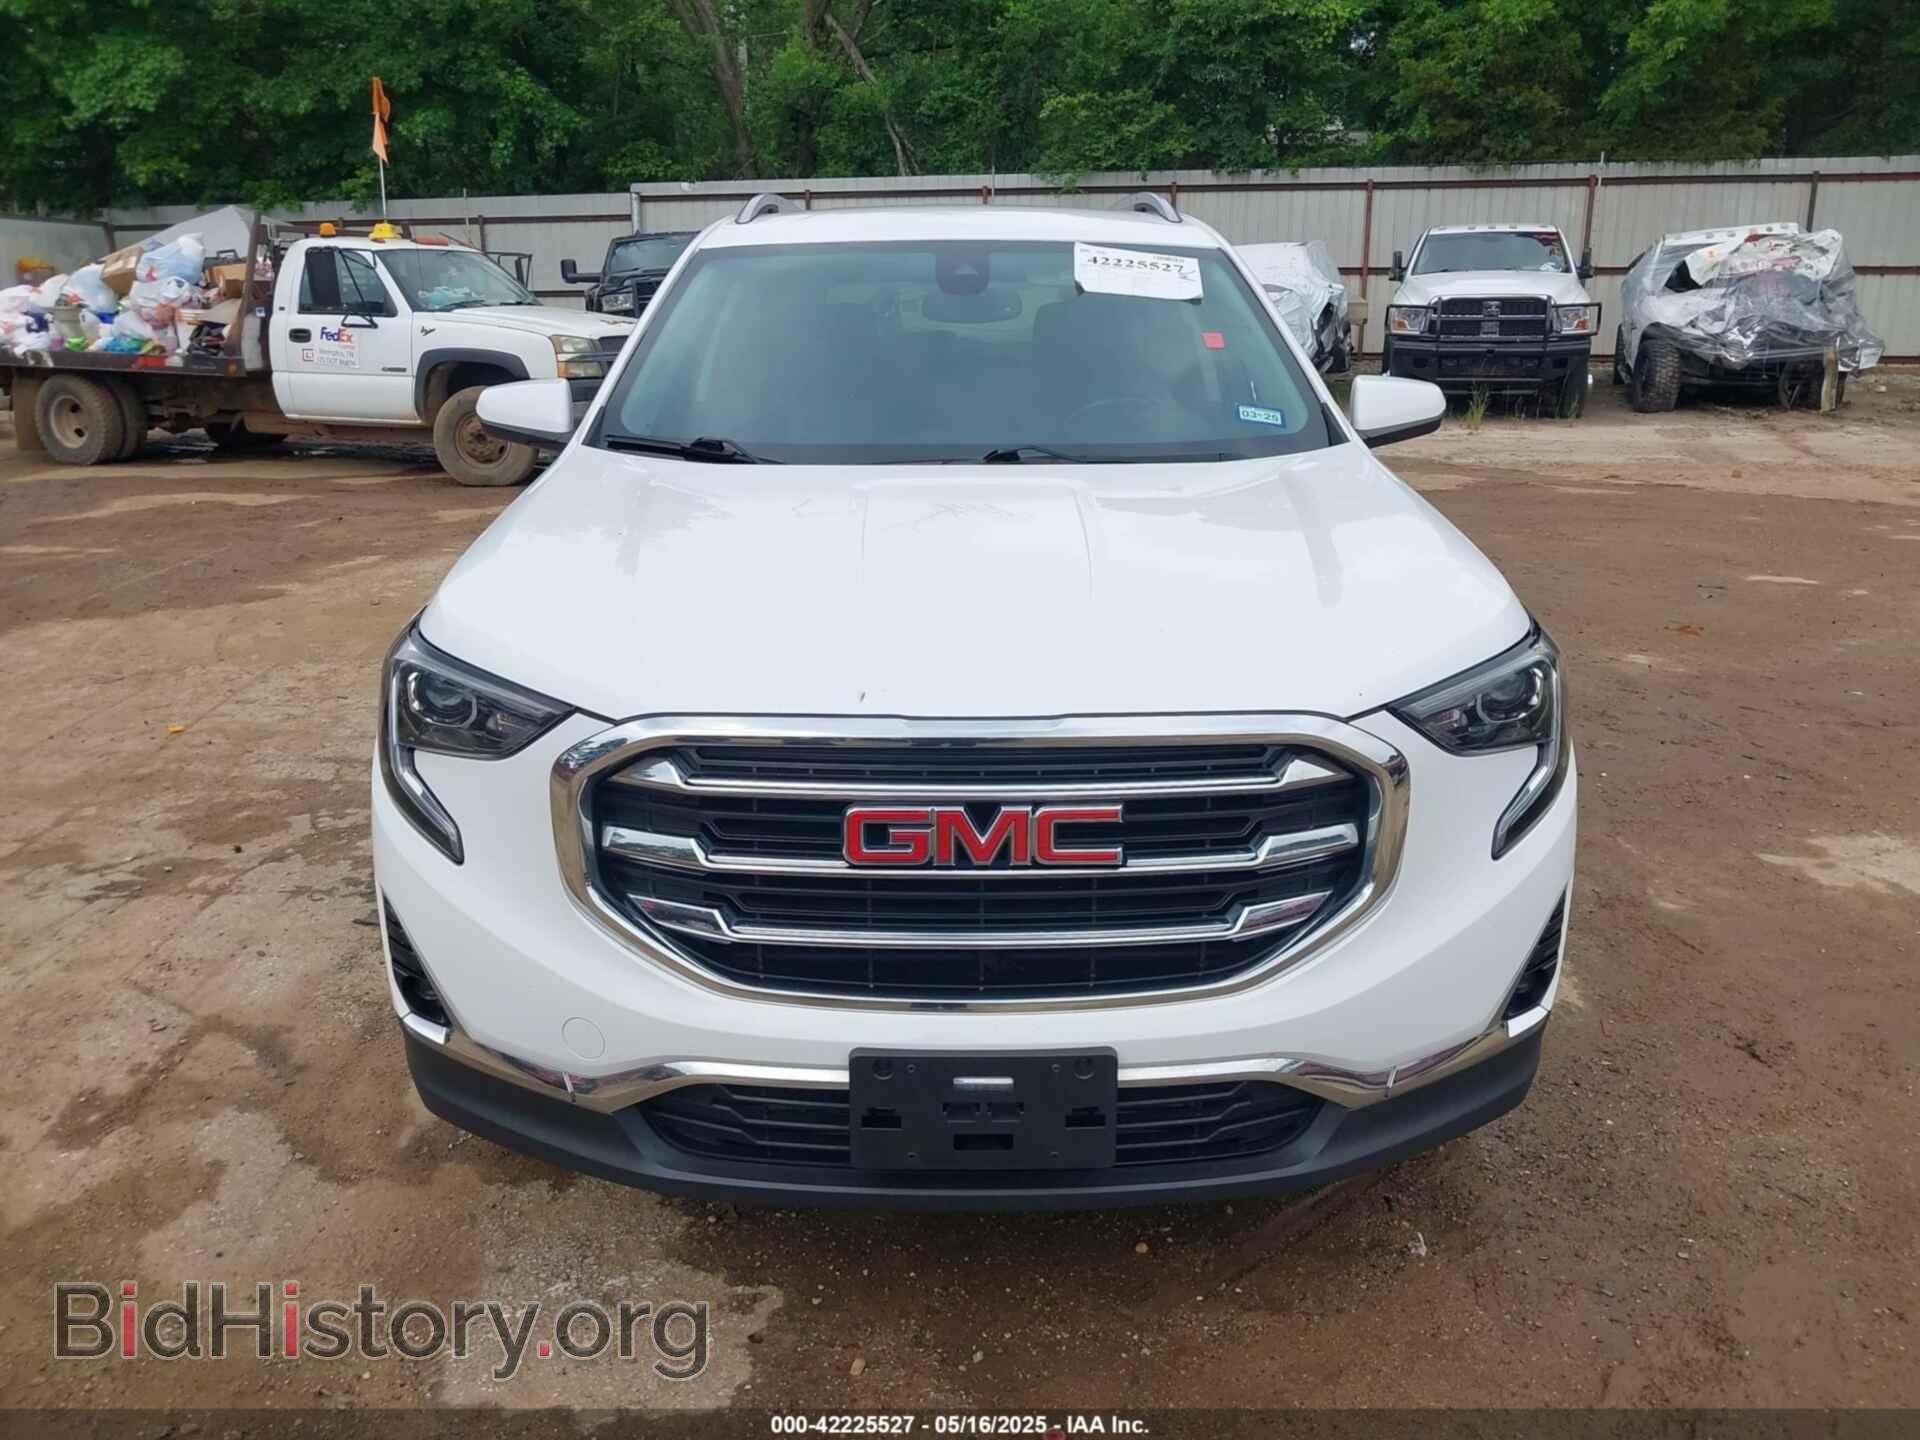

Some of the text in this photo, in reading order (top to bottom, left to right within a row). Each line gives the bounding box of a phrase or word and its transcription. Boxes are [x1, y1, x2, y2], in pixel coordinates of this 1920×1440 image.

[1087, 256, 1184, 273] 42225527
[320, 326, 352, 343] FedEx
[843, 805, 1122, 866] GMC
